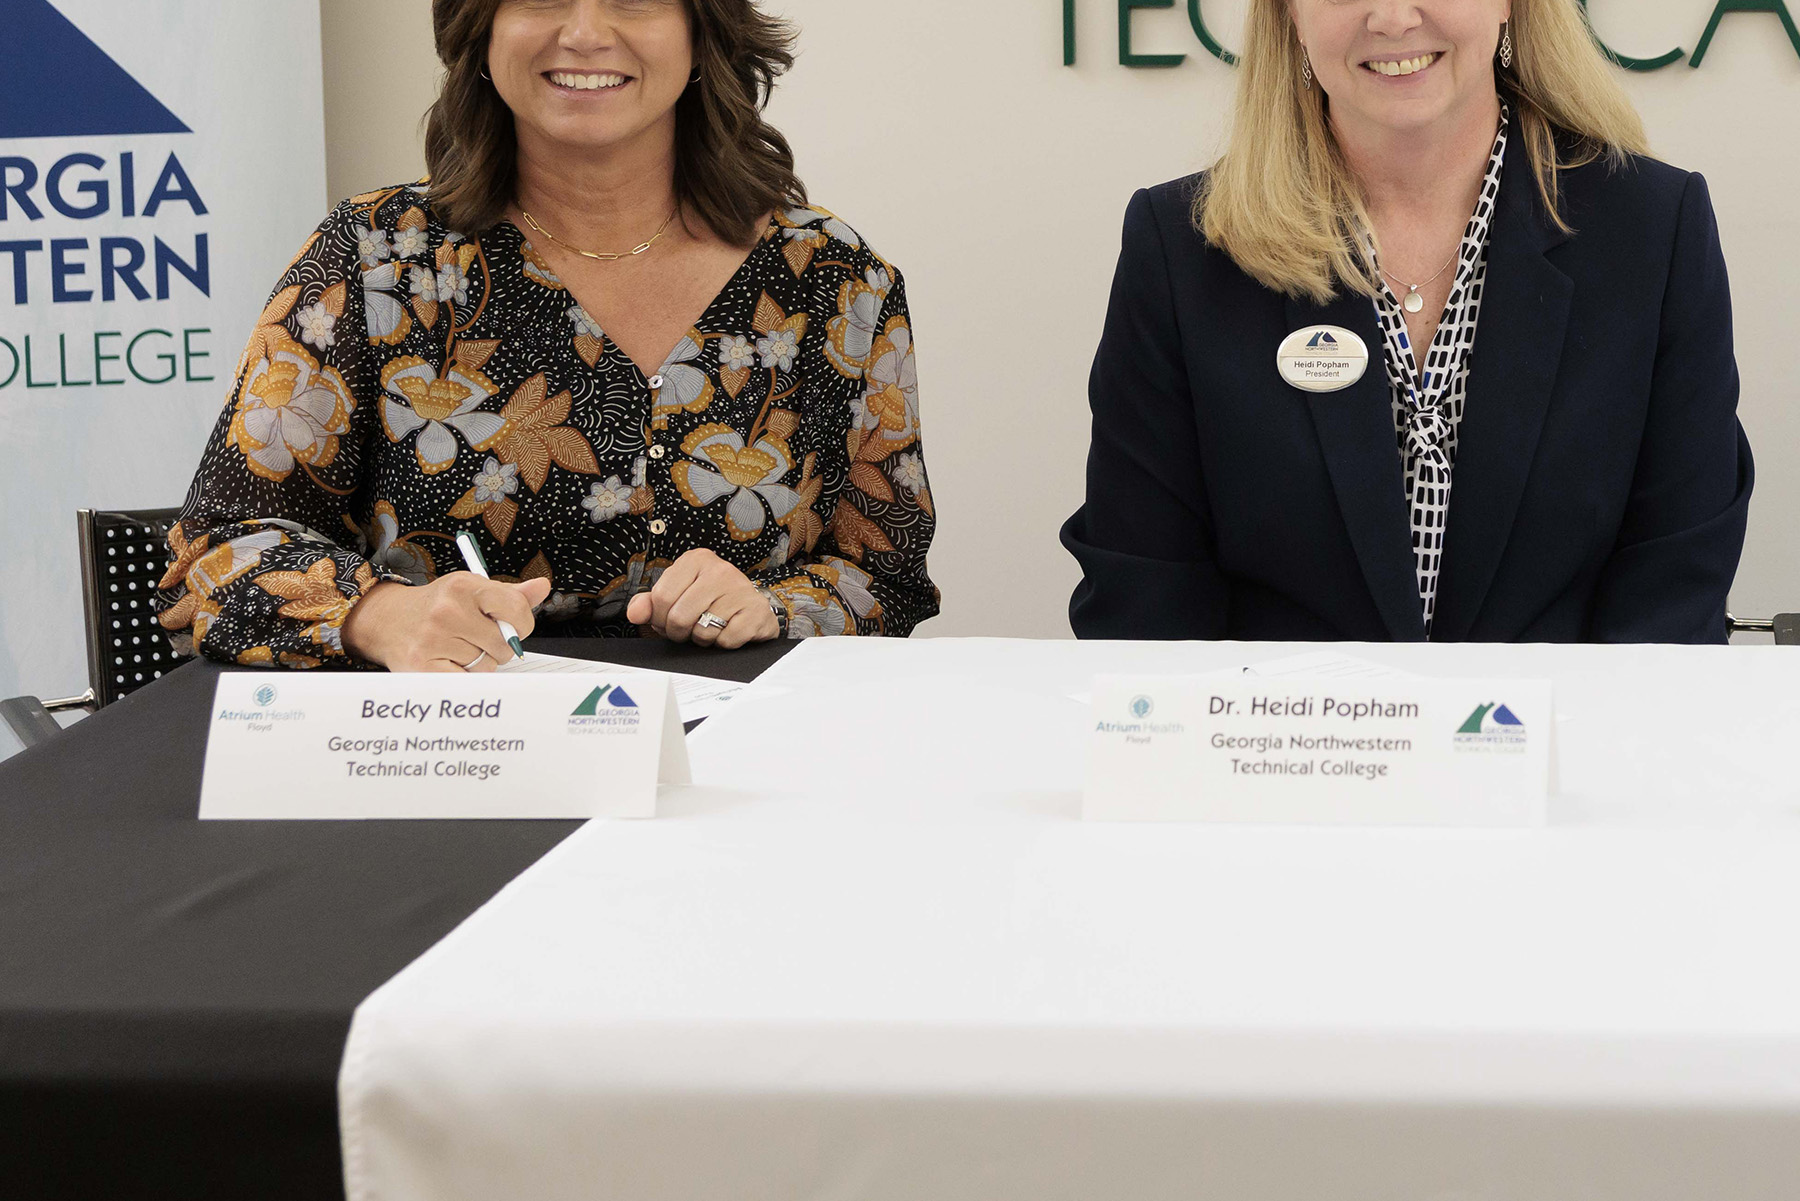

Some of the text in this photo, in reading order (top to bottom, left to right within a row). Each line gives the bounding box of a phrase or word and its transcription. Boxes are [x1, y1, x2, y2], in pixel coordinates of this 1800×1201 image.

[0, 150, 209, 221] RGIA
[0, 232, 211, 305] TERN
[1316, 361, 1349, 370] Popham
[218, 709, 306, 721] Atrium Health
[361, 698, 502, 720] Becky Redd
[1209, 696, 1419, 721] Dr. Heidi Popham
[247, 722, 273, 732] Floyd
[1095, 720, 1141, 733] Atrium
[327, 736, 525, 755] Georgia Northwestern
[1210, 733, 1412, 753] Georgia Northwestern
[346, 760, 501, 780] Technical College
[1231, 757, 1388, 780] Technical College
